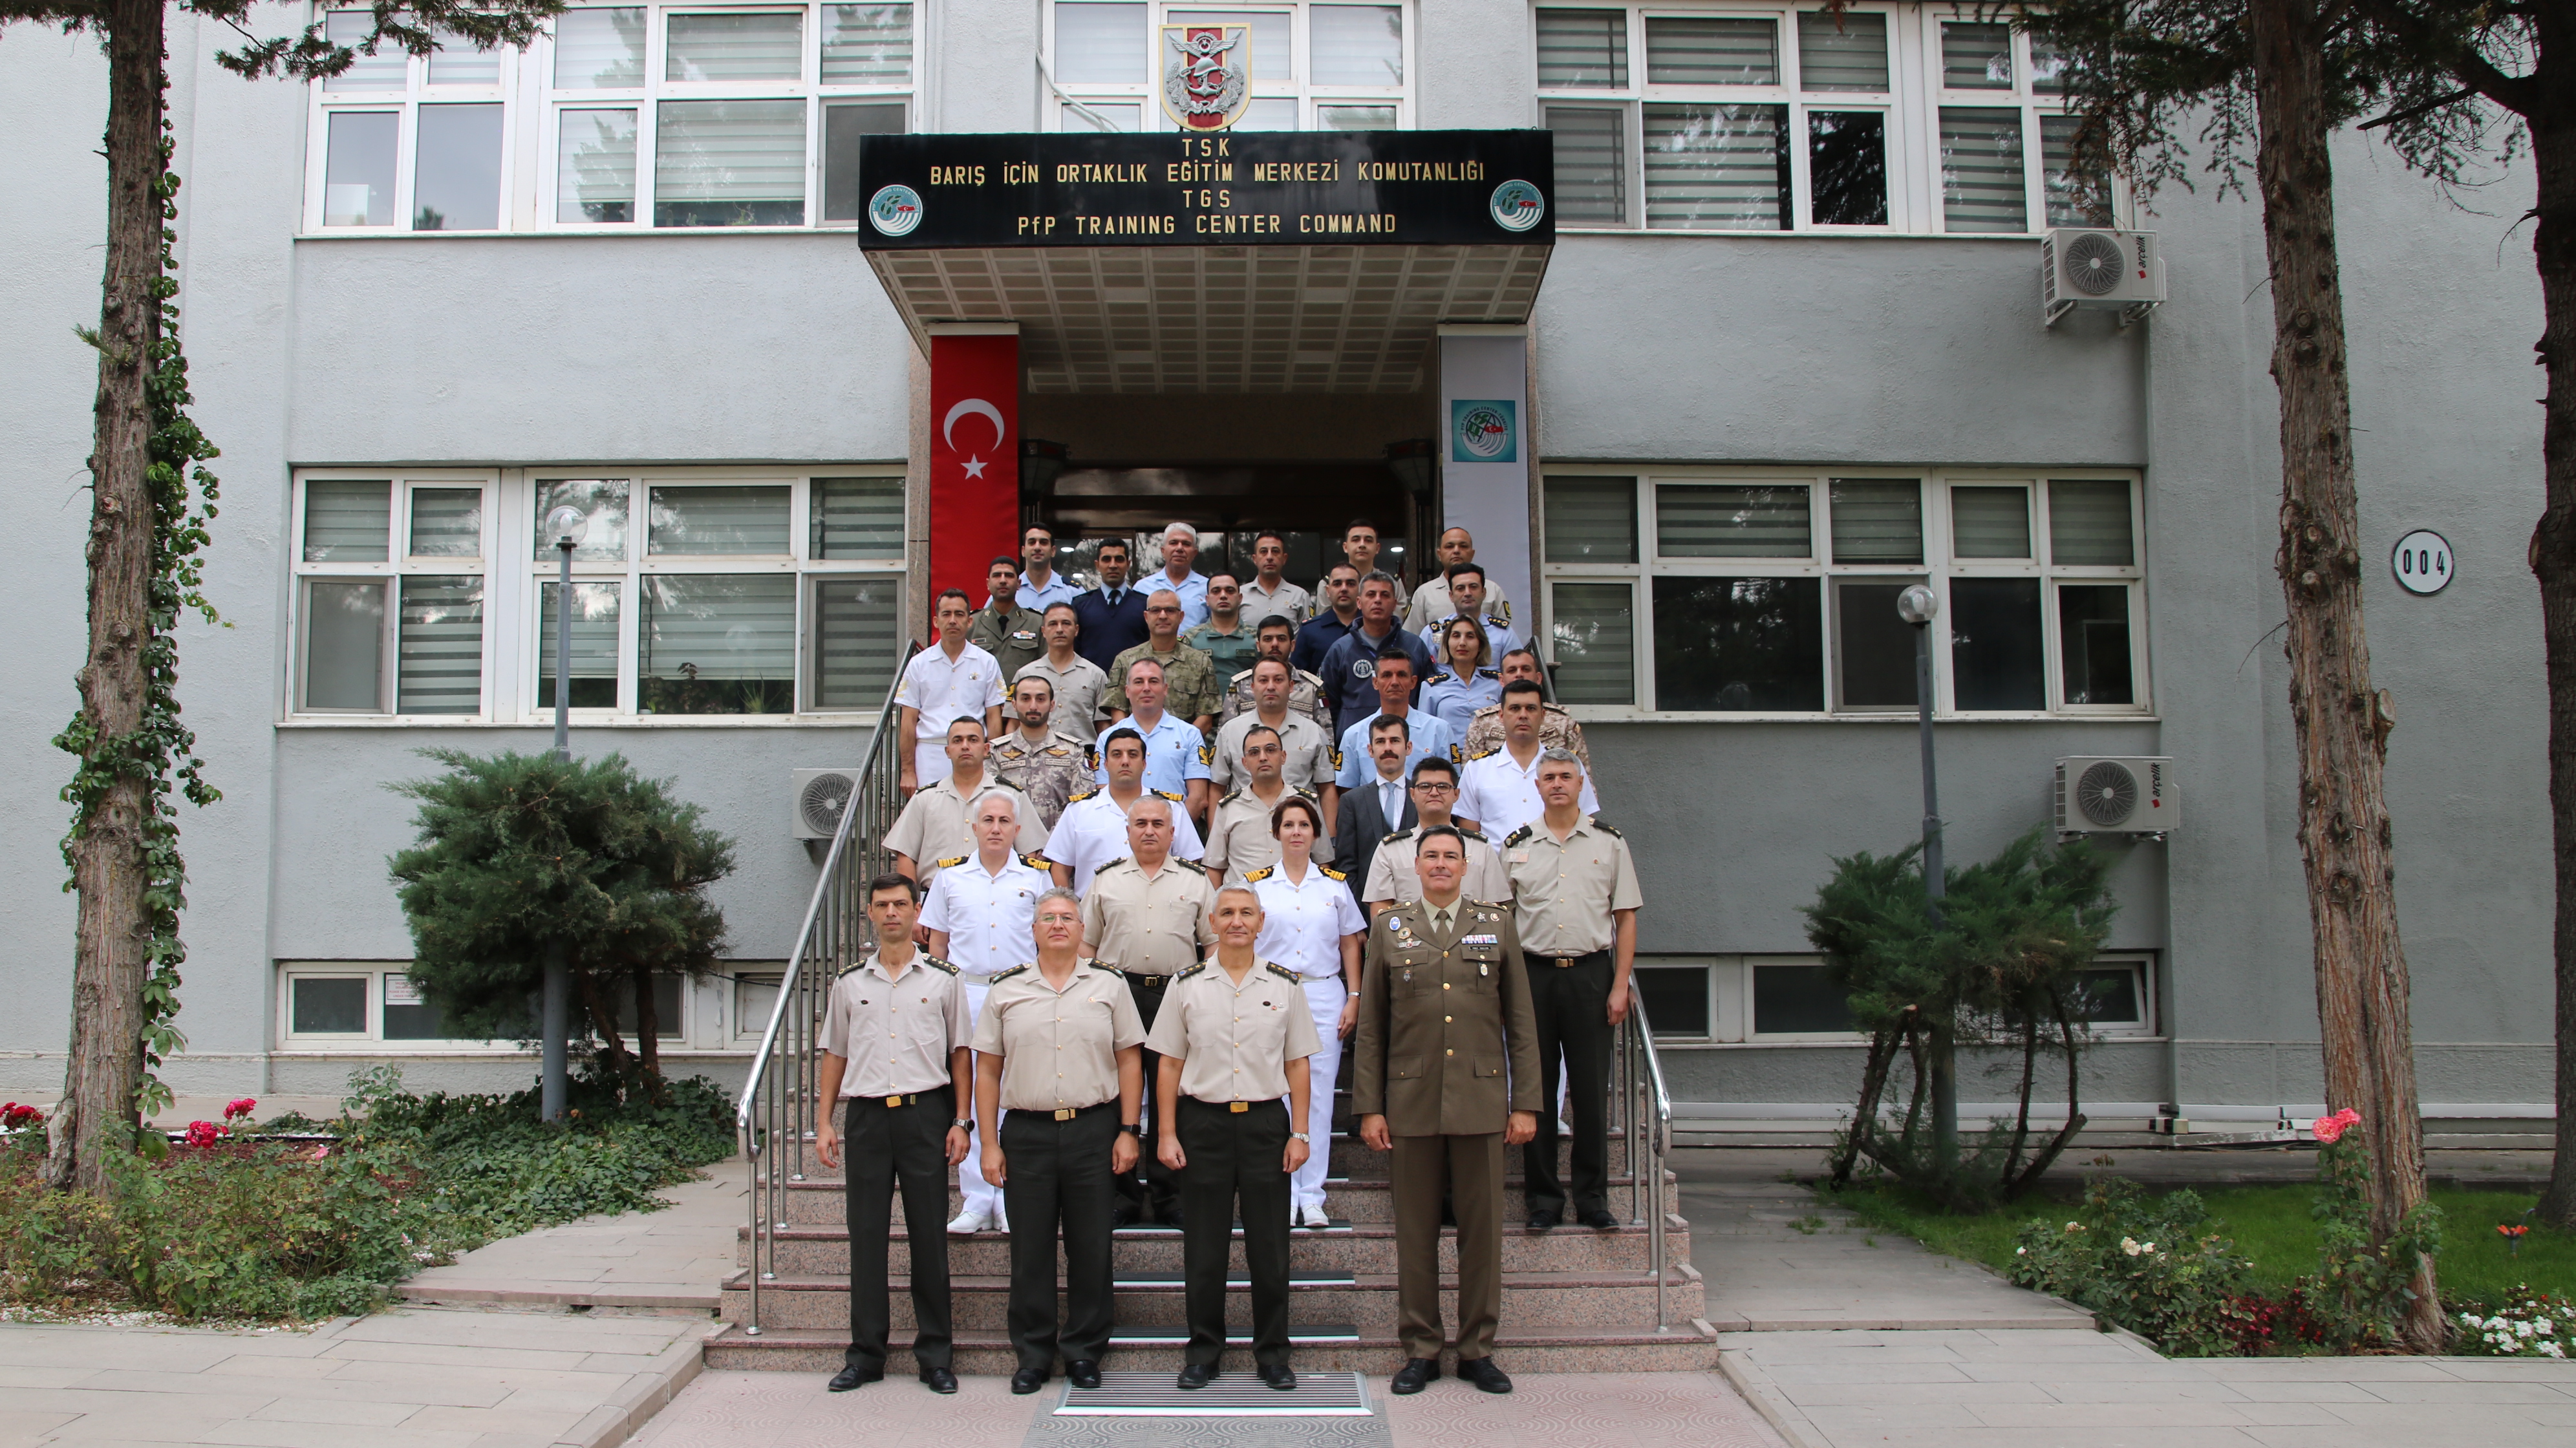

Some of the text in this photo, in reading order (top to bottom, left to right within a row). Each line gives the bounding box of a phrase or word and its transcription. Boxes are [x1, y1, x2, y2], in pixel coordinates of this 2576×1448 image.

[1182, 138, 1229, 156] TSK
[930, 159, 1484, 186] BARIŞ İÇİN ORTAKLIK EĞİTİM MERKEZİ KOMUTANLIĞI
[874, 187, 892, 203] TRAINING
[1183, 189, 1230, 208] TGS
[1495, 182, 1514, 197] TRAINING
[1018, 214, 1395, 235] PfP TRAINING CENTER COMMAND
[2136, 235, 2148, 269] arçelik
[2403, 548, 2445, 576] 004
[2151, 762, 2163, 797] arçelik
